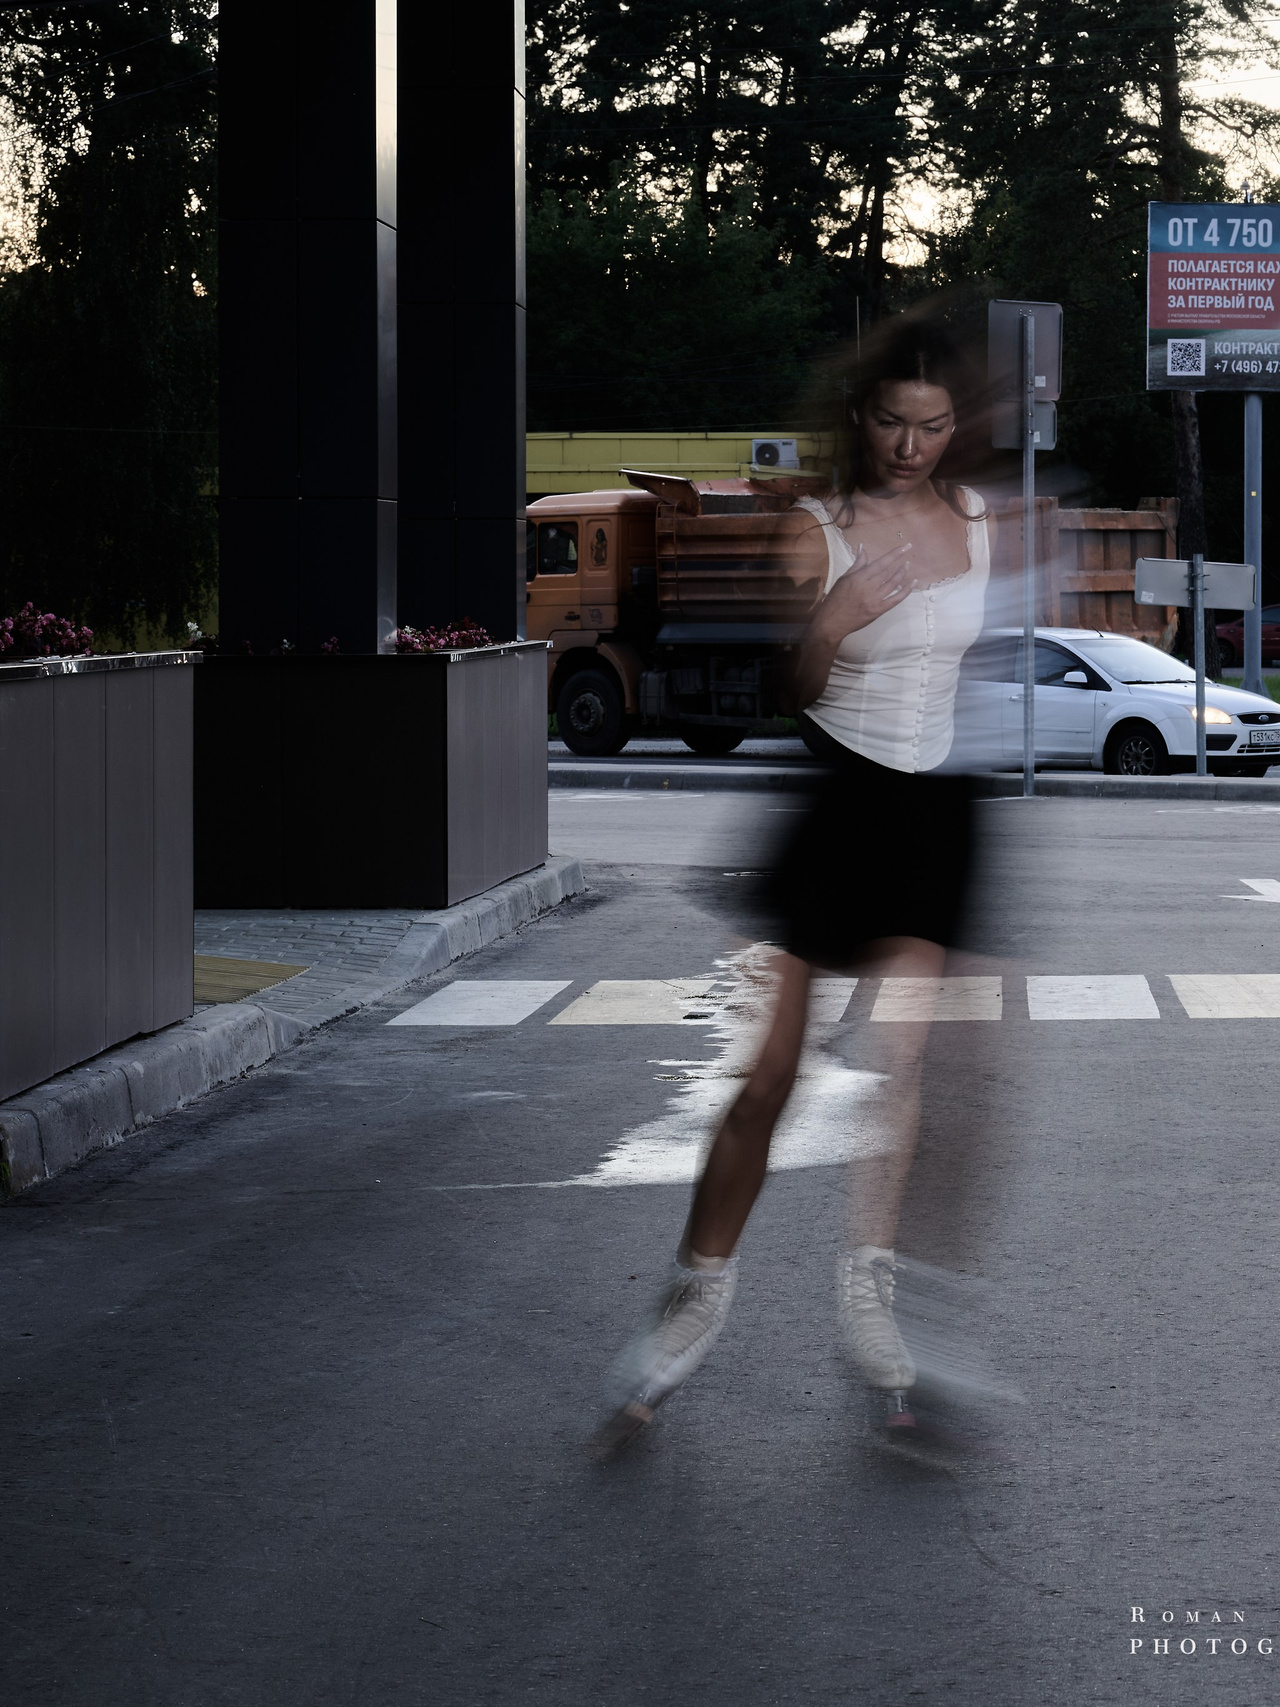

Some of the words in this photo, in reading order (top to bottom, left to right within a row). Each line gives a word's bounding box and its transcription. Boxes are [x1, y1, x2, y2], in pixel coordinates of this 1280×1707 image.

[1167, 217, 1199, 247] ОТ
[1203, 218, 1220, 247] 4
[1226, 218, 1273, 248] 750
[1167, 259, 1254, 274] ПОЛАГАЕТСЯ
[1167, 277, 1276, 292] КОНТРАКТНИКУ
[1167, 294, 1186, 309] ЗА
[1188, 292, 1245, 309] ПЕРВЫЙ
[1248, 295, 1275, 312] ГОД
[1214, 361, 1229, 373] +7
[1230, 360, 1263, 374] (496)
